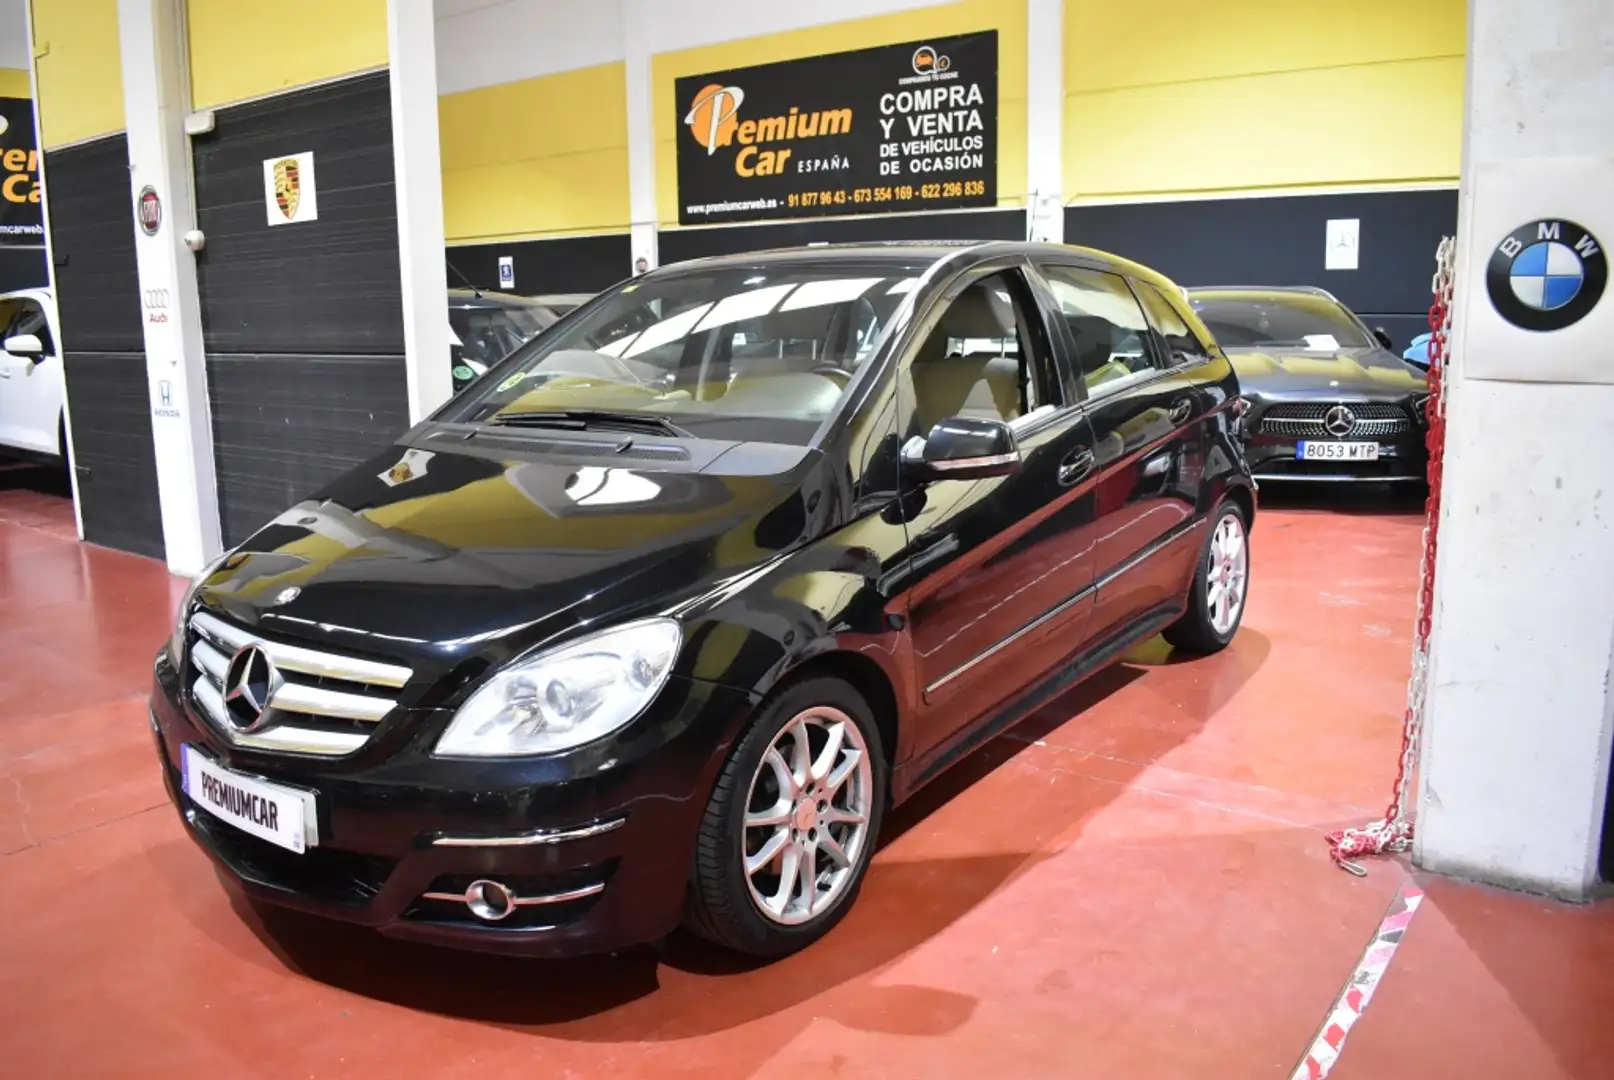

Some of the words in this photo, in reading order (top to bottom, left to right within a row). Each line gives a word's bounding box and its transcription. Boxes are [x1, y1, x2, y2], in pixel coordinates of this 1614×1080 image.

[880, 83, 984, 115] COMPRA
[684, 86, 853, 156] Premium
[879, 118, 895, 140] Y
[906, 109, 984, 137] VENTA
[735, 145, 792, 178] Car
[797, 154, 850, 173] ESPAÑA
[880, 142, 899, 158] DE
[901, 135, 983, 156] VEHÍCULOS
[880, 161, 900, 176] DE
[909, 152, 983, 174] OCASIÓN
[788, 193, 799, 208] 91
[834, 190, 846, 204] 43
[854, 188, 871, 203] 673
[874, 186, 892, 201] 554
[894, 185, 912, 200] 169
[921, 184, 941, 199] 622
[942, 182, 962, 197] 296
[964, 180, 984, 195] 836
[1499, 222, 1600, 258] BMW
[148, 312, 169, 323] Audi
[1307, 444, 1344, 458] 8053
[1349, 444, 1376, 458] MTP
[201, 771, 279, 832] PREMIUMCAR
